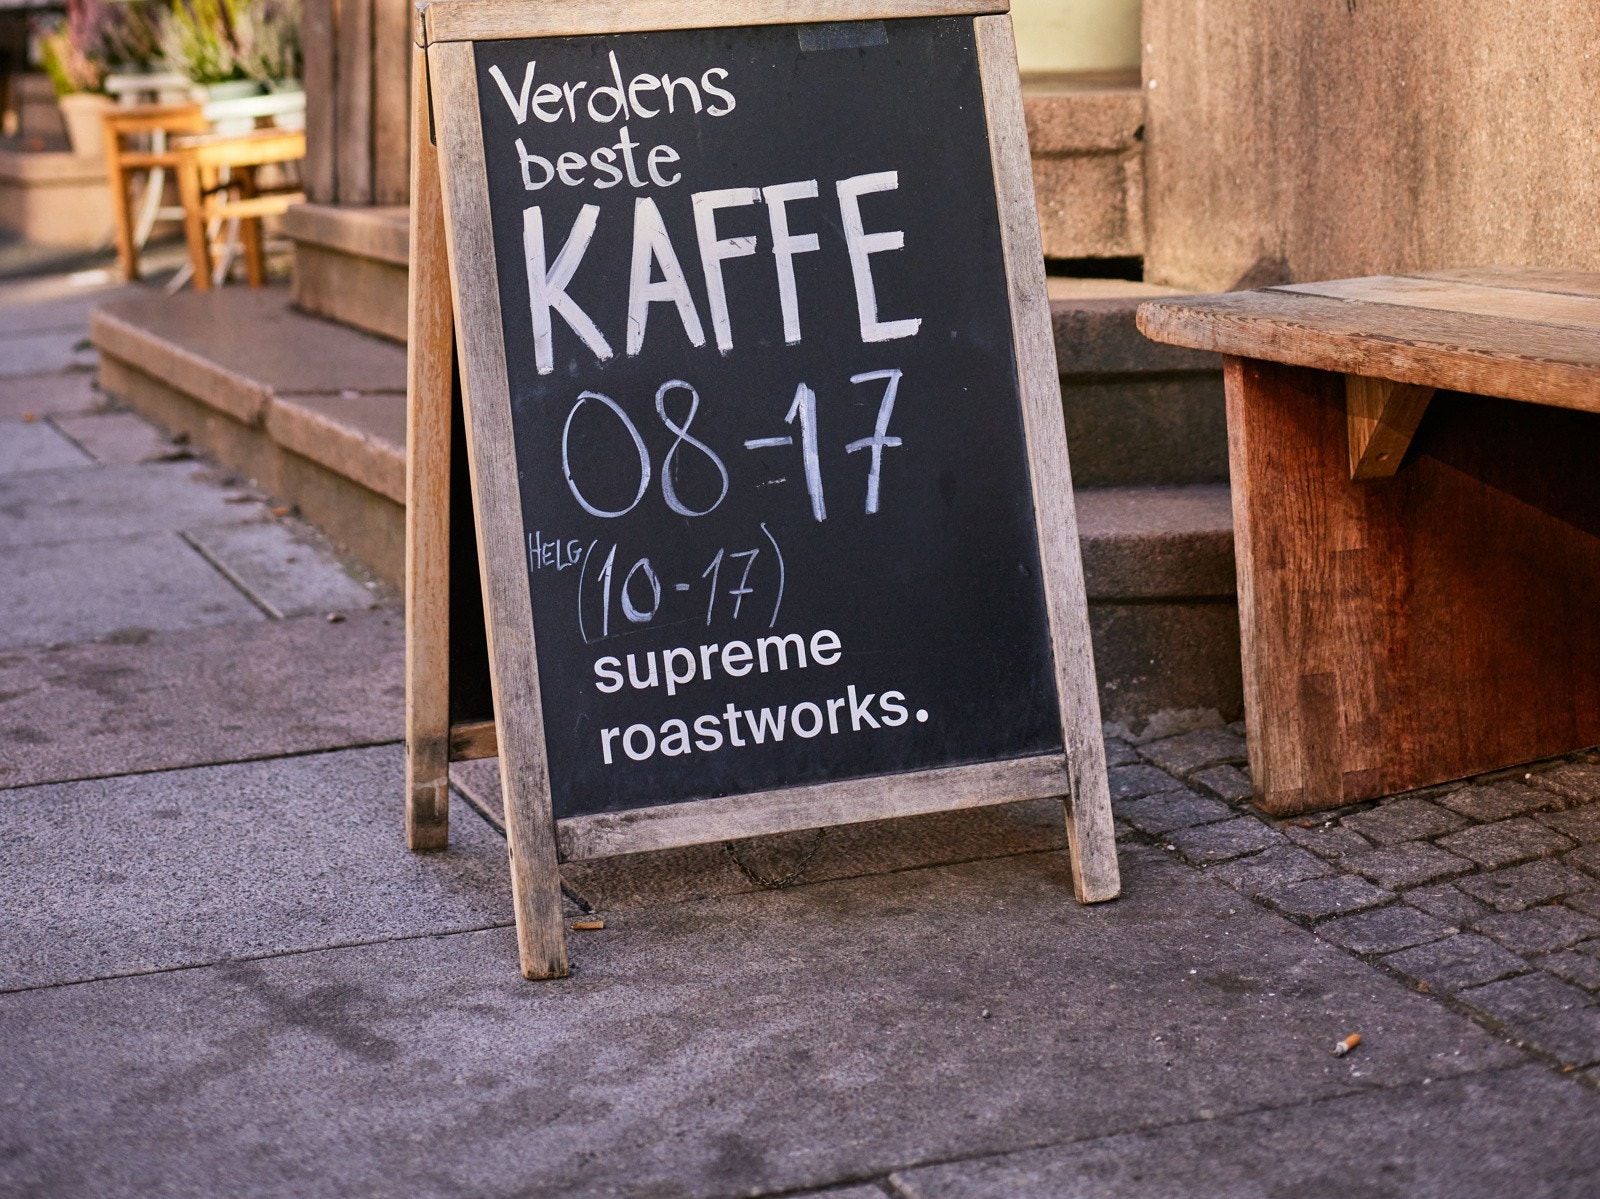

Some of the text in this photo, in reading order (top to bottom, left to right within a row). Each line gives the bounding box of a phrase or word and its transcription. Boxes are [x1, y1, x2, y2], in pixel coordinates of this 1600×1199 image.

[488, 50, 737, 125] Verdens
[515, 126, 682, 191] beste
[523, 170, 922, 375] KAFFE
[529, 531, 582, 573] HELG
[593, 628, 842, 695] supreme
[600, 685, 929, 765] roastworks.
